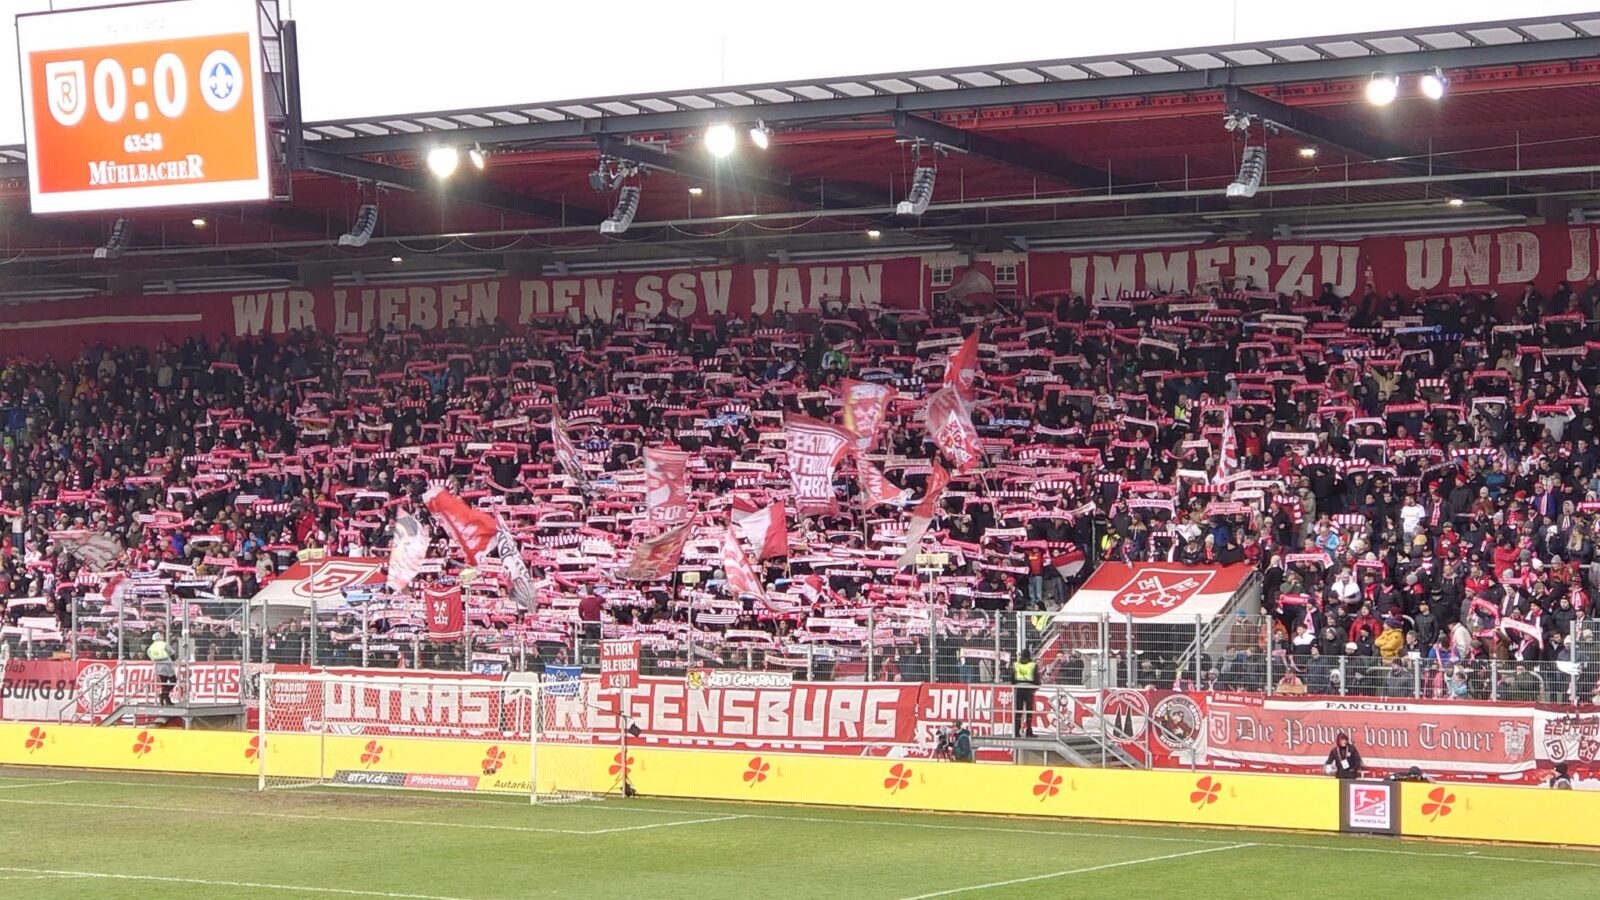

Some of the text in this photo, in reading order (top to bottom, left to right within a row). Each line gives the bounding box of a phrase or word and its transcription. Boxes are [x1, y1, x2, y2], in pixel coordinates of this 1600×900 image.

[88, 154, 205, 186] MÜHLBACHER
[231, 228, 1600, 337] WIR LIEBEN DEN SSV JAHN IMMERZU UND J
[603, 642, 634, 656] STARK
[602, 658, 638, 672] BLEIBEN
[54, 679, 77, 700] 81
[708, 672, 792, 688] RED GENERATION
[325, 674, 490, 724] ULTRAS
[552, 684, 900, 739] REGENSBURG
[925, 688, 992, 720] JAHN
[1325, 702, 1407, 711] FANCLUB
[1235, 715, 1274, 742] Die
[1364, 721, 1409, 748] vom
[1418, 721, 1496, 751] Tower
[410, 775, 470, 787] Photovoltaik
